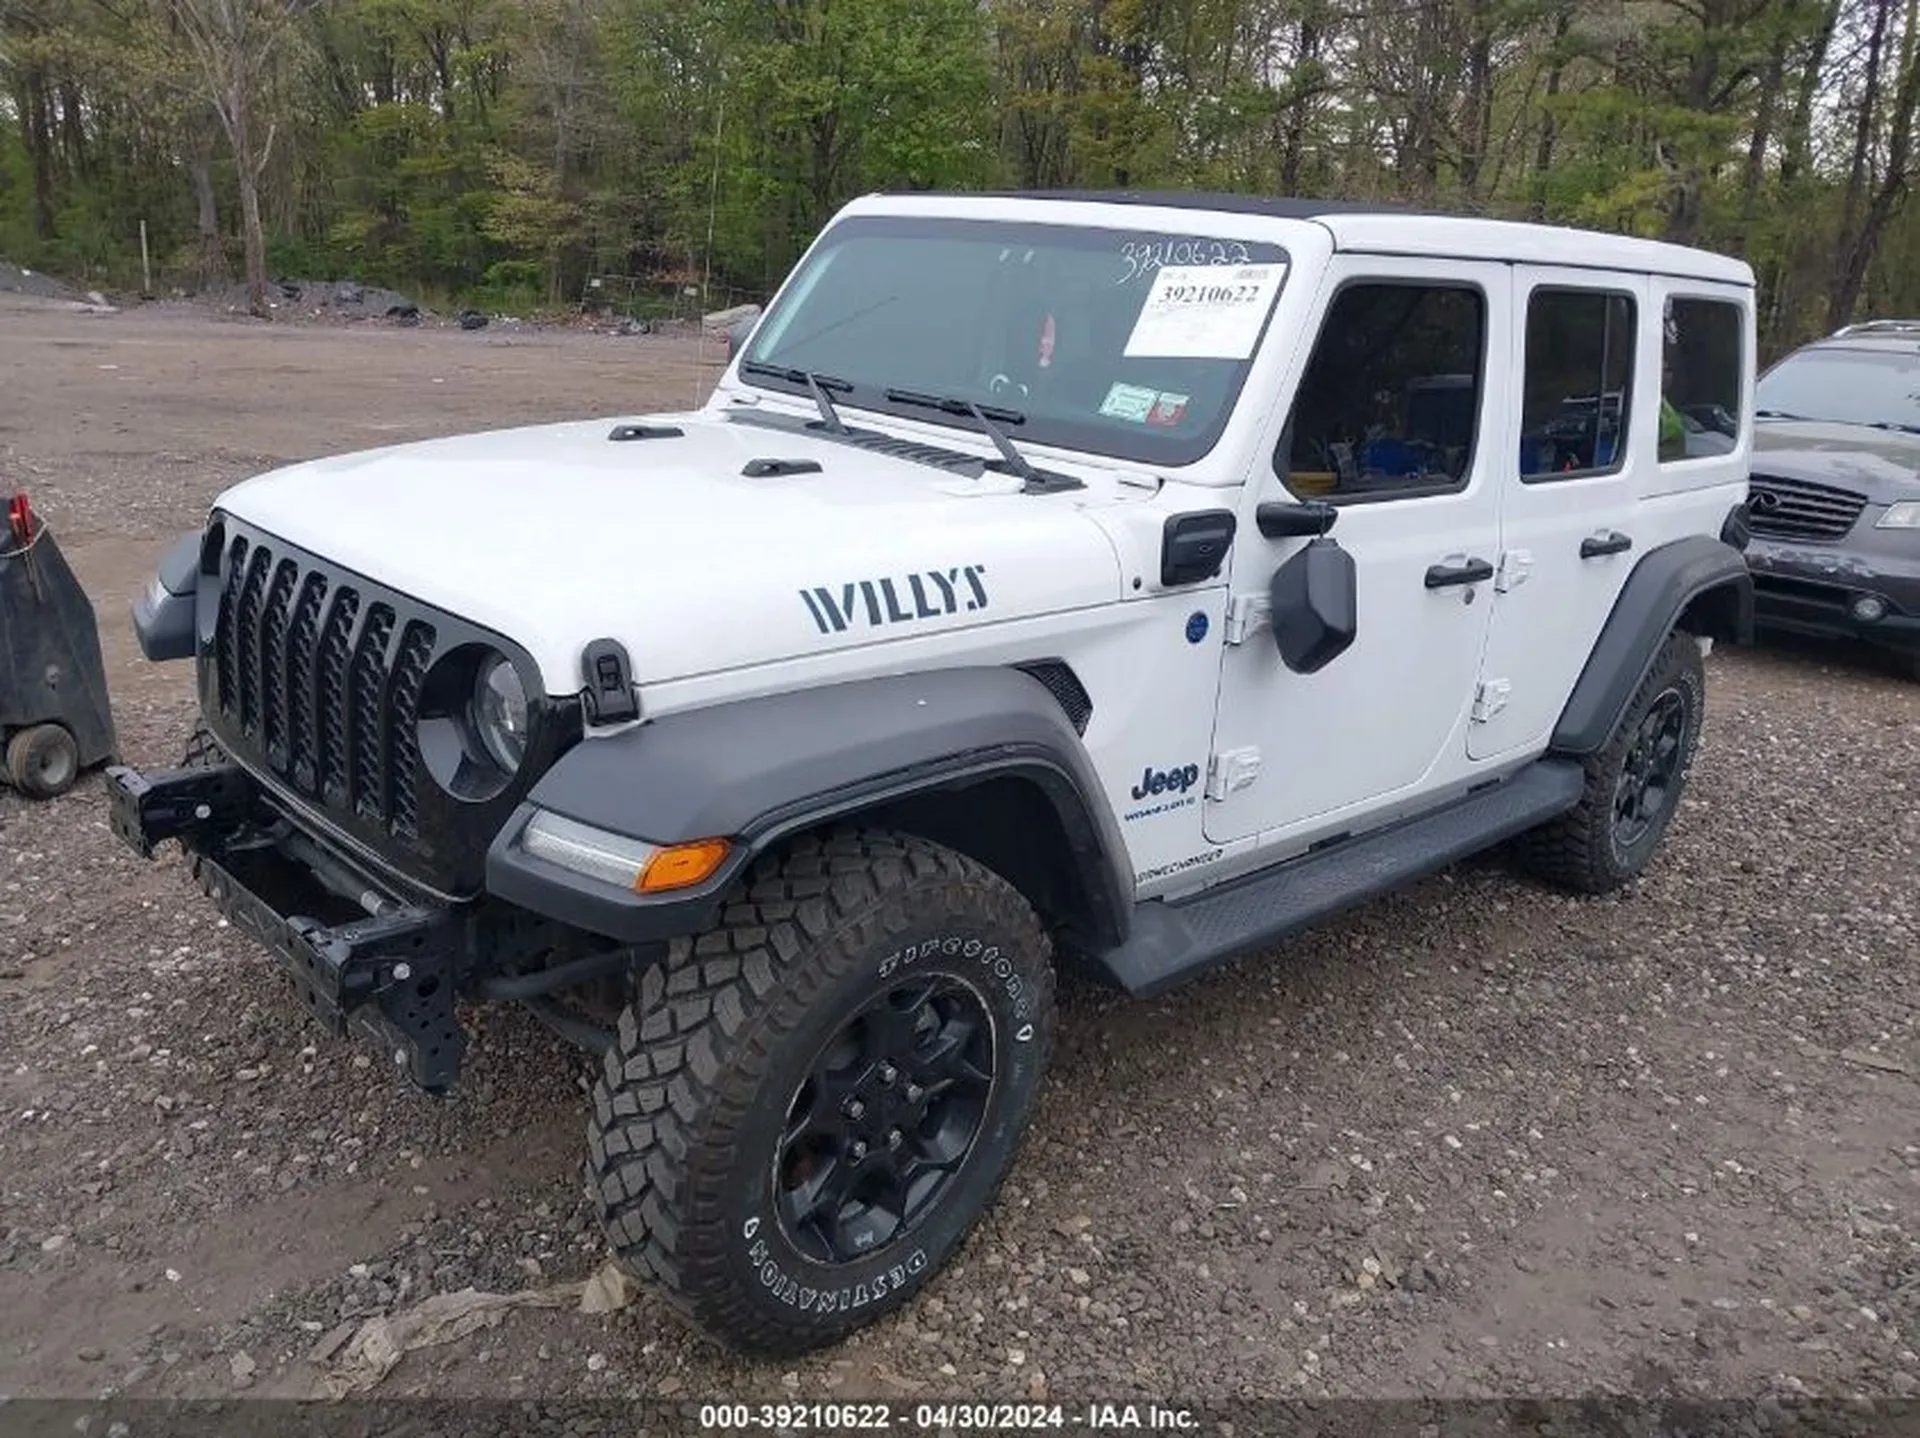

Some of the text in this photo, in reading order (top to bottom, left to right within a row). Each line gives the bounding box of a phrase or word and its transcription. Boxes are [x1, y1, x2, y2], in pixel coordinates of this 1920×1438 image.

[1117, 241, 1251, 285] 39210622
[1158, 285, 1260, 303] 39210622
[799, 564, 988, 634] WILLYS
[1131, 763, 1198, 800] Jeep
[749, 1239, 928, 1313] DESTINATION
